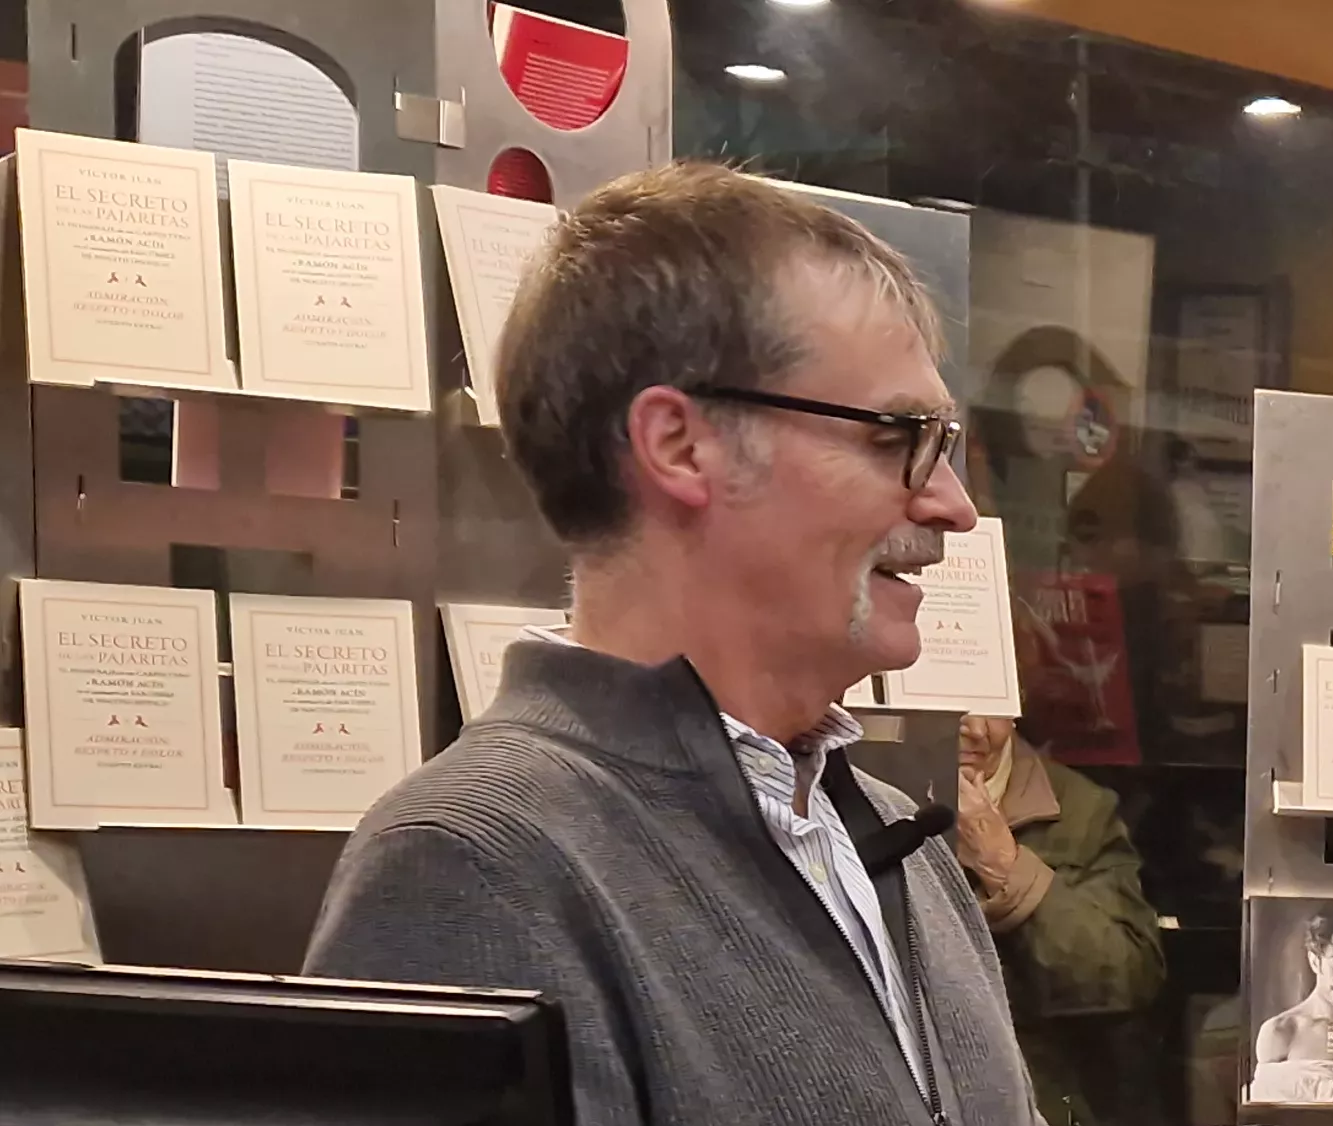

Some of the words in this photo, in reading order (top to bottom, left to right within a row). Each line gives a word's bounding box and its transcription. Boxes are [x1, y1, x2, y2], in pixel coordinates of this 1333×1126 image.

[132, 174, 161, 185] JUAN
[55, 184, 81, 200] EL
[86, 189, 187, 213] SECRETO
[96, 208, 189, 229] PAJARITAS
[265, 213, 290, 227] EL
[294, 216, 390, 236] SECRETO
[303, 233, 391, 251] PAJARITAS
[927, 569, 989, 583] PAJARITAS
[133, 616, 162, 625] JUAN
[58, 632, 83, 647] EL
[88, 633, 187, 652] SECRETO
[98, 651, 189, 667] PAJARITAS
[265, 644, 289, 657] EL
[294, 645, 387, 662] SECRETO
[303, 661, 388, 676] PAJARITAS
